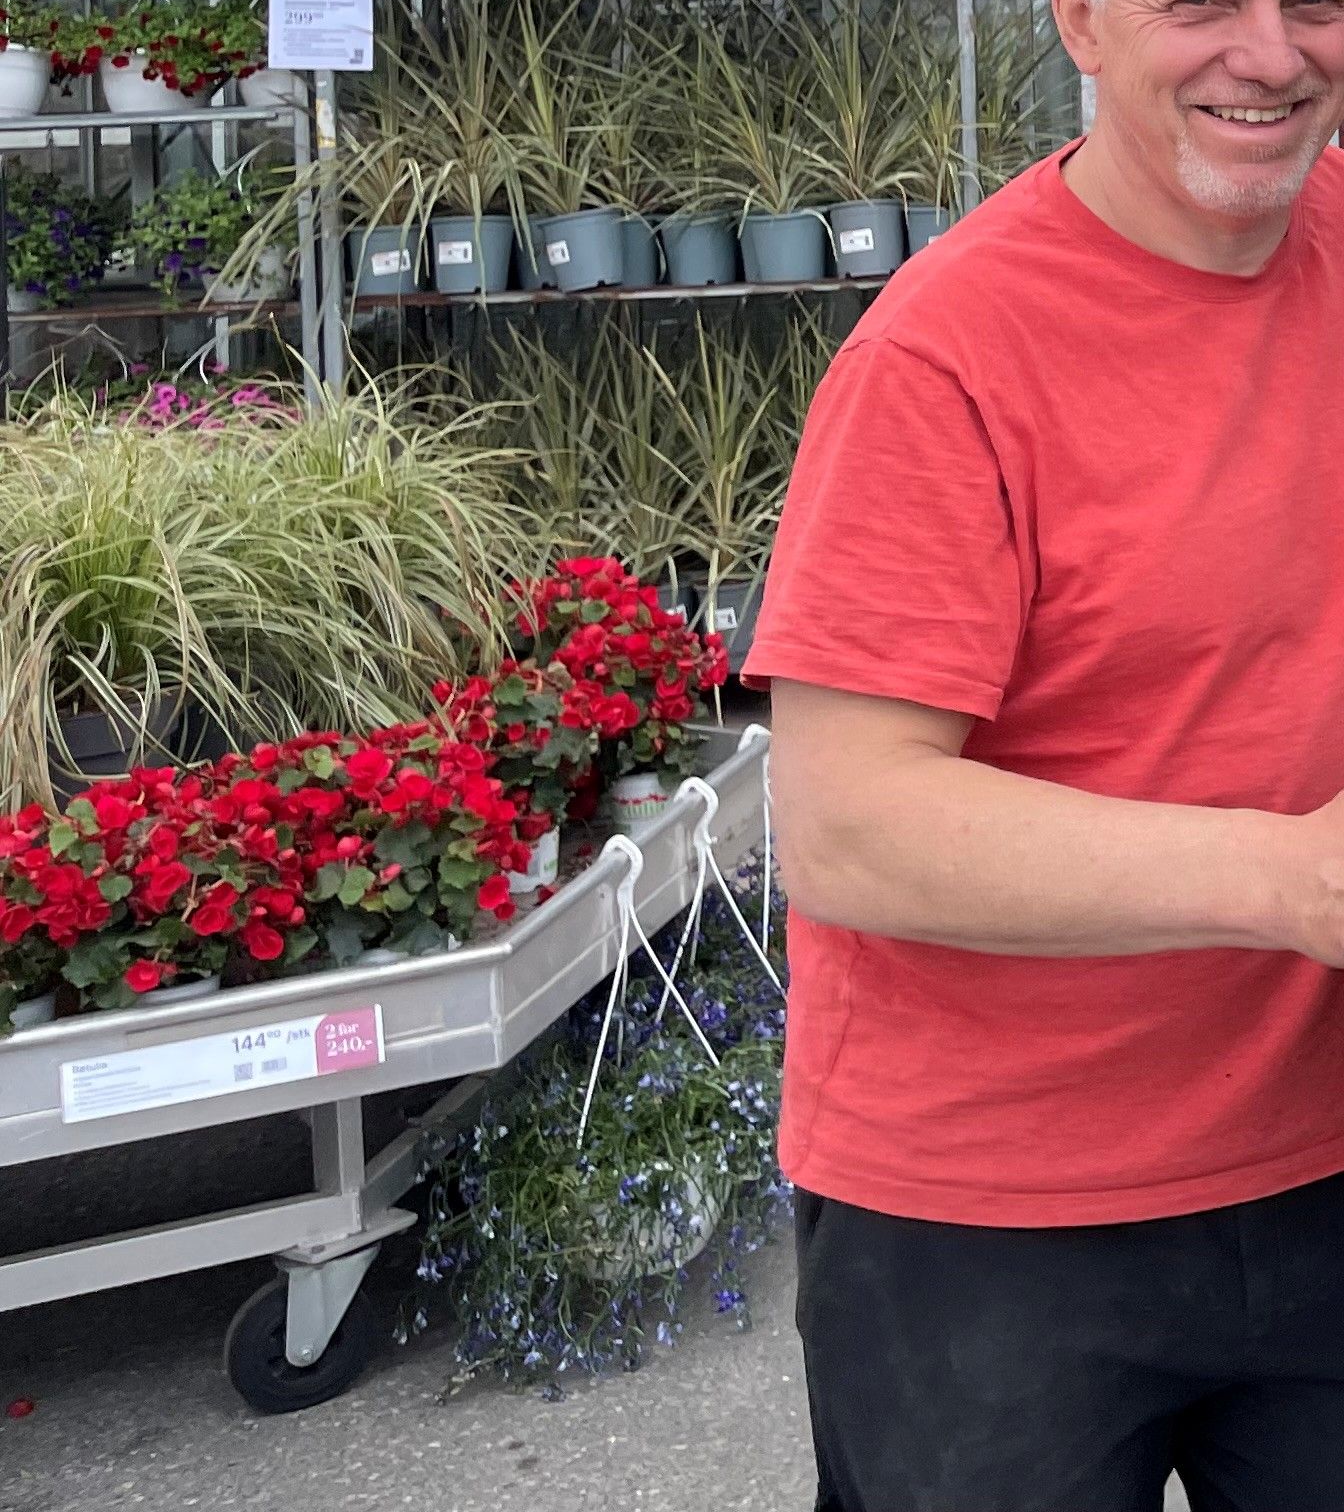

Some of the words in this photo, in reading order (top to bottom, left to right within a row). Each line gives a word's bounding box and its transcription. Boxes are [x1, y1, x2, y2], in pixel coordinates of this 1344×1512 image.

[324, 1023, 337, 1039] 2
[338, 1022, 360, 1035] for
[231, 1032, 266, 1053] 144
